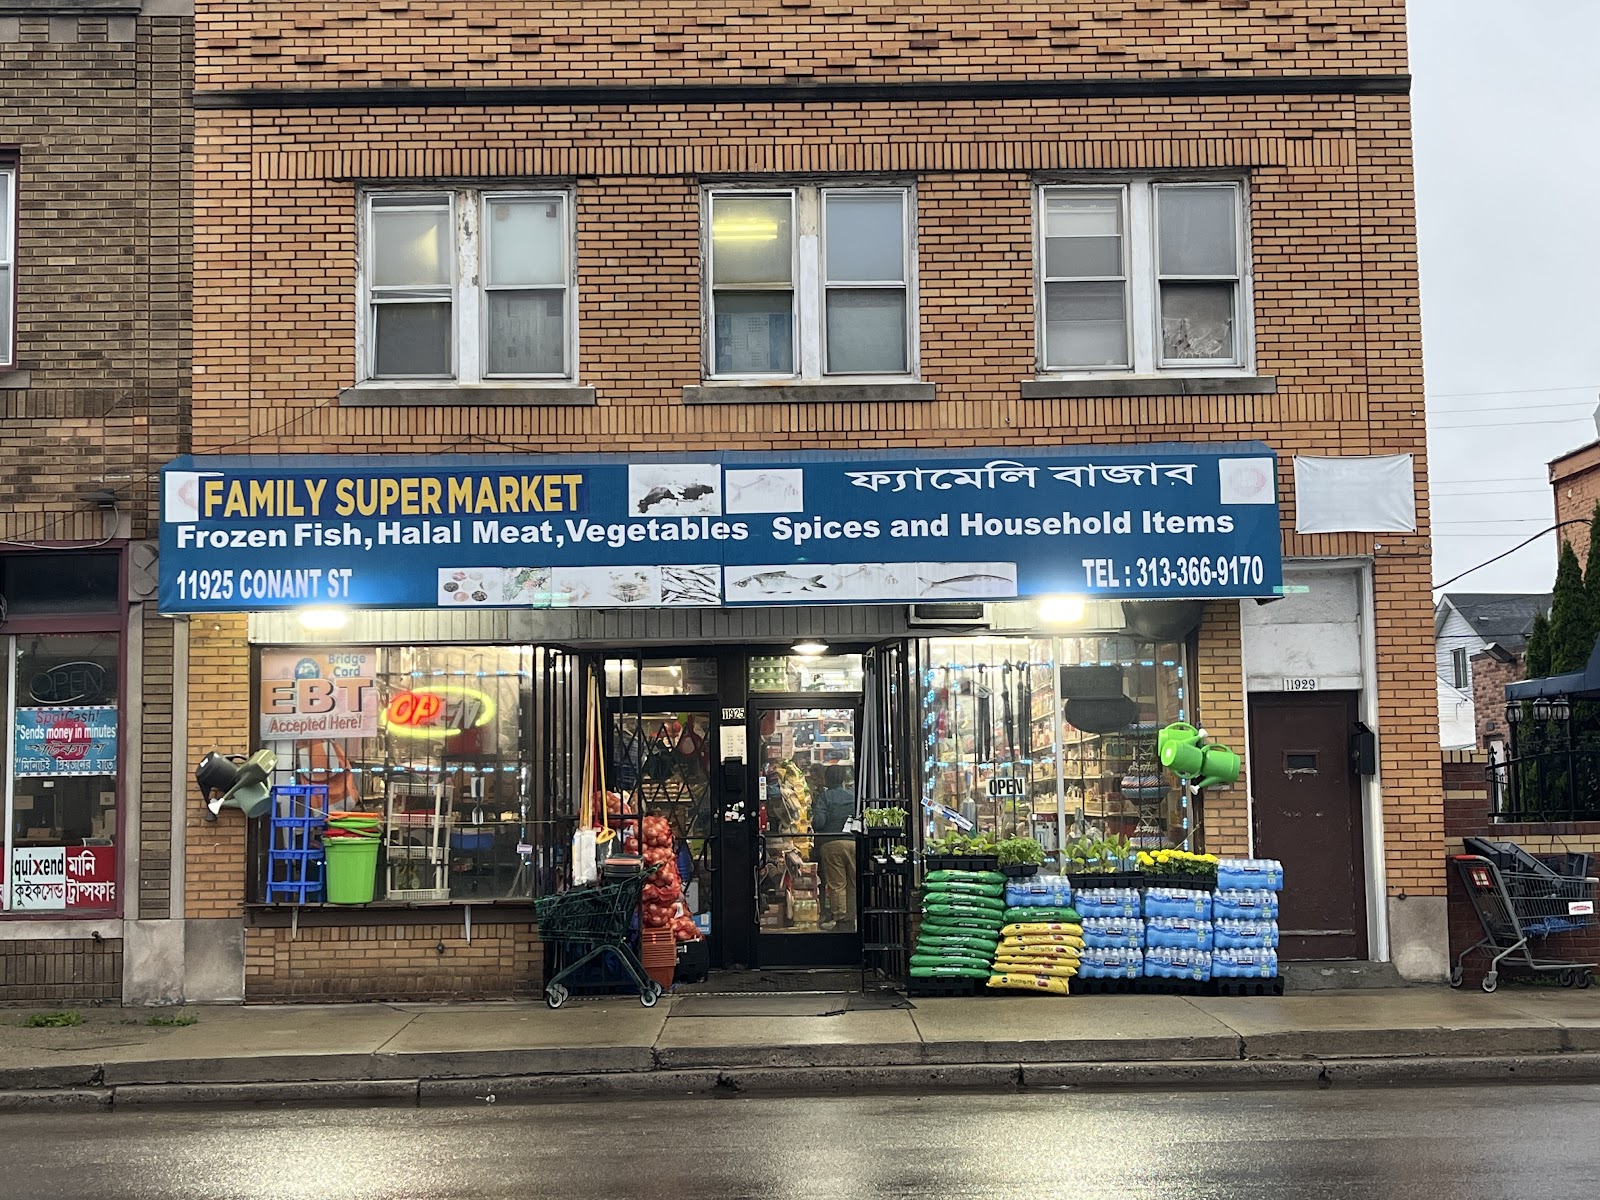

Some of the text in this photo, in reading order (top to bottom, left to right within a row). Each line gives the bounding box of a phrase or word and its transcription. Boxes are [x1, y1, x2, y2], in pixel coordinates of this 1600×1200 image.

[845, 461, 1198, 492] ফ্যামেলি বাজার
[205, 474, 583, 518] FAMILY SUPER MARKET
[177, 510, 1235, 551] Frozen Fish, Halal Meat, Vegetables Spices and Household Items
[176, 568, 353, 600] 11925 CONANT ST
[1136, 556, 1264, 587] 313-366-9170
[328, 653, 366, 670] Bridge
[333, 666, 361, 677] Card
[30, 670, 103, 696] OPEN
[262, 677, 374, 714] EBT
[1286, 679, 1316, 690] 11929
[269, 714, 362, 734] Accepted Here!
[723, 708, 745, 719] 11925
[46, 728, 74, 742] money
[75, 724, 82, 739] in
[989, 779, 1023, 795] OPEN
[14, 853, 64, 881] quixend
[67, 849, 96, 876] মানি
